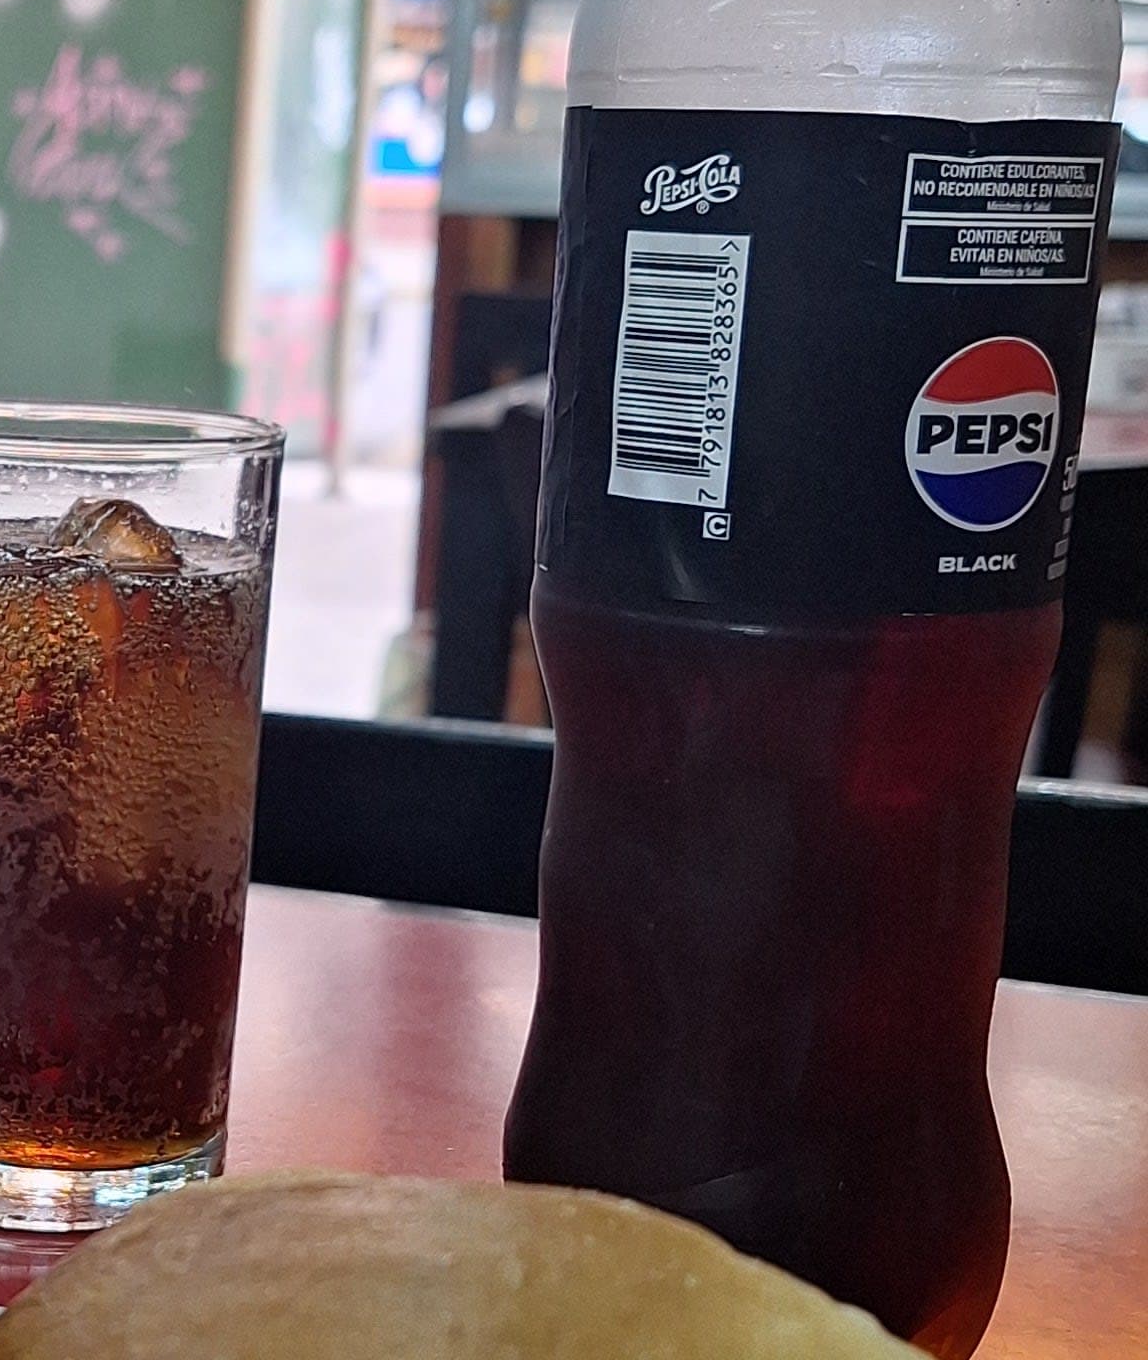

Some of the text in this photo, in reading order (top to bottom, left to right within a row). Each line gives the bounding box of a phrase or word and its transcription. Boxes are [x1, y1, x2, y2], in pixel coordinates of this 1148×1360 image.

[941, 163, 1005, 178] CONTIENE
[914, 180, 935, 196] NO
[938, 182, 1037, 197] RECOMENDABLE
[1039, 183, 1053, 197] EN
[958, 229, 1018, 244] CONTIENE
[950, 248, 995, 262] EVITAR
[997, 249, 1013, 263] EN
[698, 265, 739, 502] 7 791813 828365
[916, 412, 1054, 455] PEPSI
[938, 554, 1017, 573] BLACK
